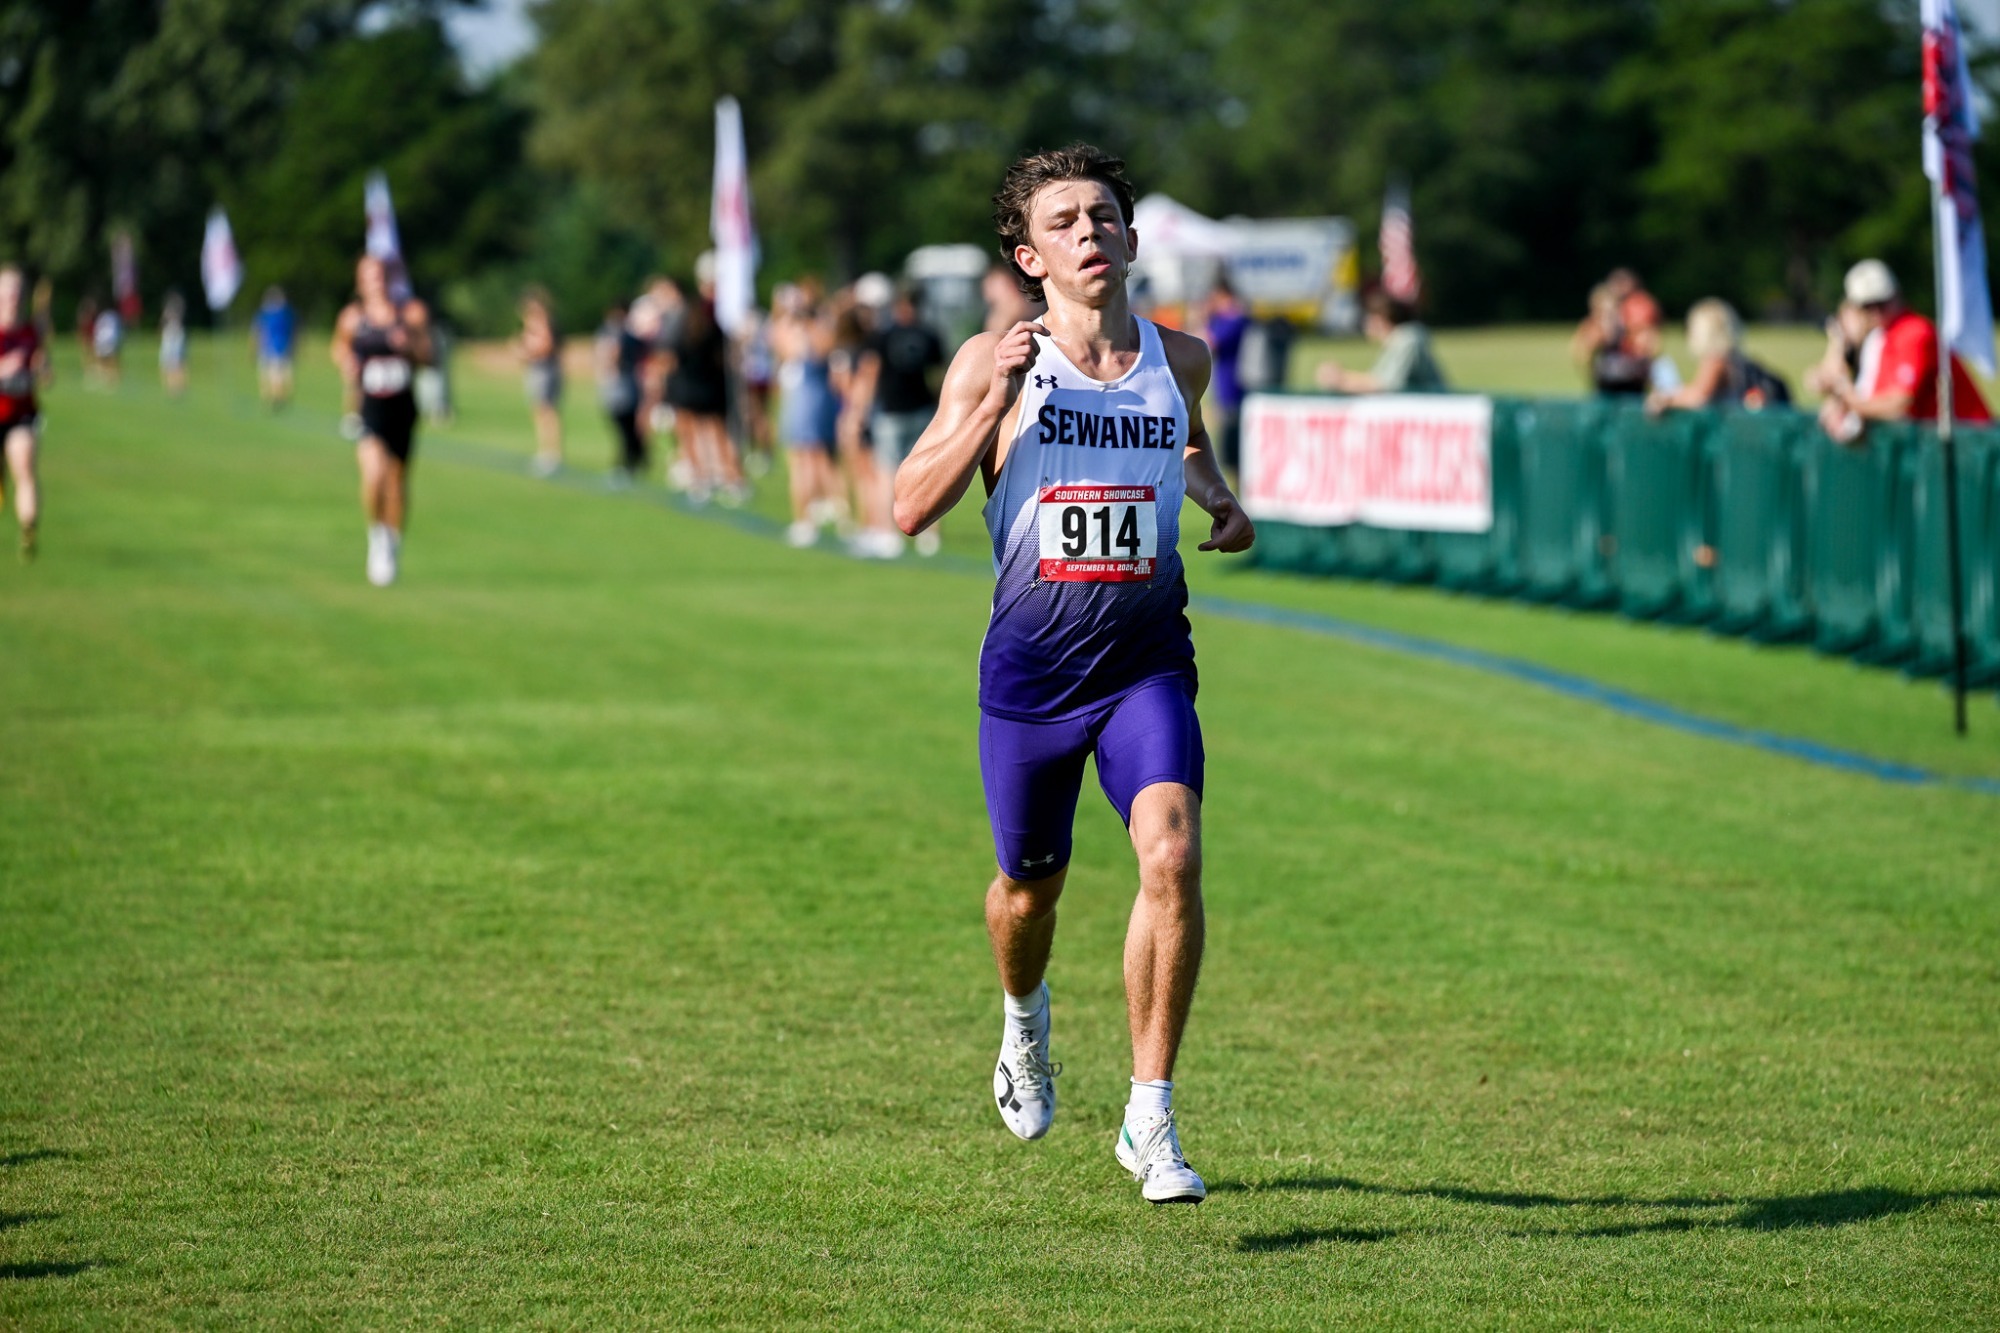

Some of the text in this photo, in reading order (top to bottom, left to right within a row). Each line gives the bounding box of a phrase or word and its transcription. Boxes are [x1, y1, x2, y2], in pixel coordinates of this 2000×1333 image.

[1038, 405, 1176, 450] SEWANEE
[1054, 489, 1146, 500] SOUTHERN SHOWCASE
[1062, 505, 1141, 557] 914
[1066, 563, 1105, 572] SEPTEMBER
[1134, 566, 1152, 575] STATE
